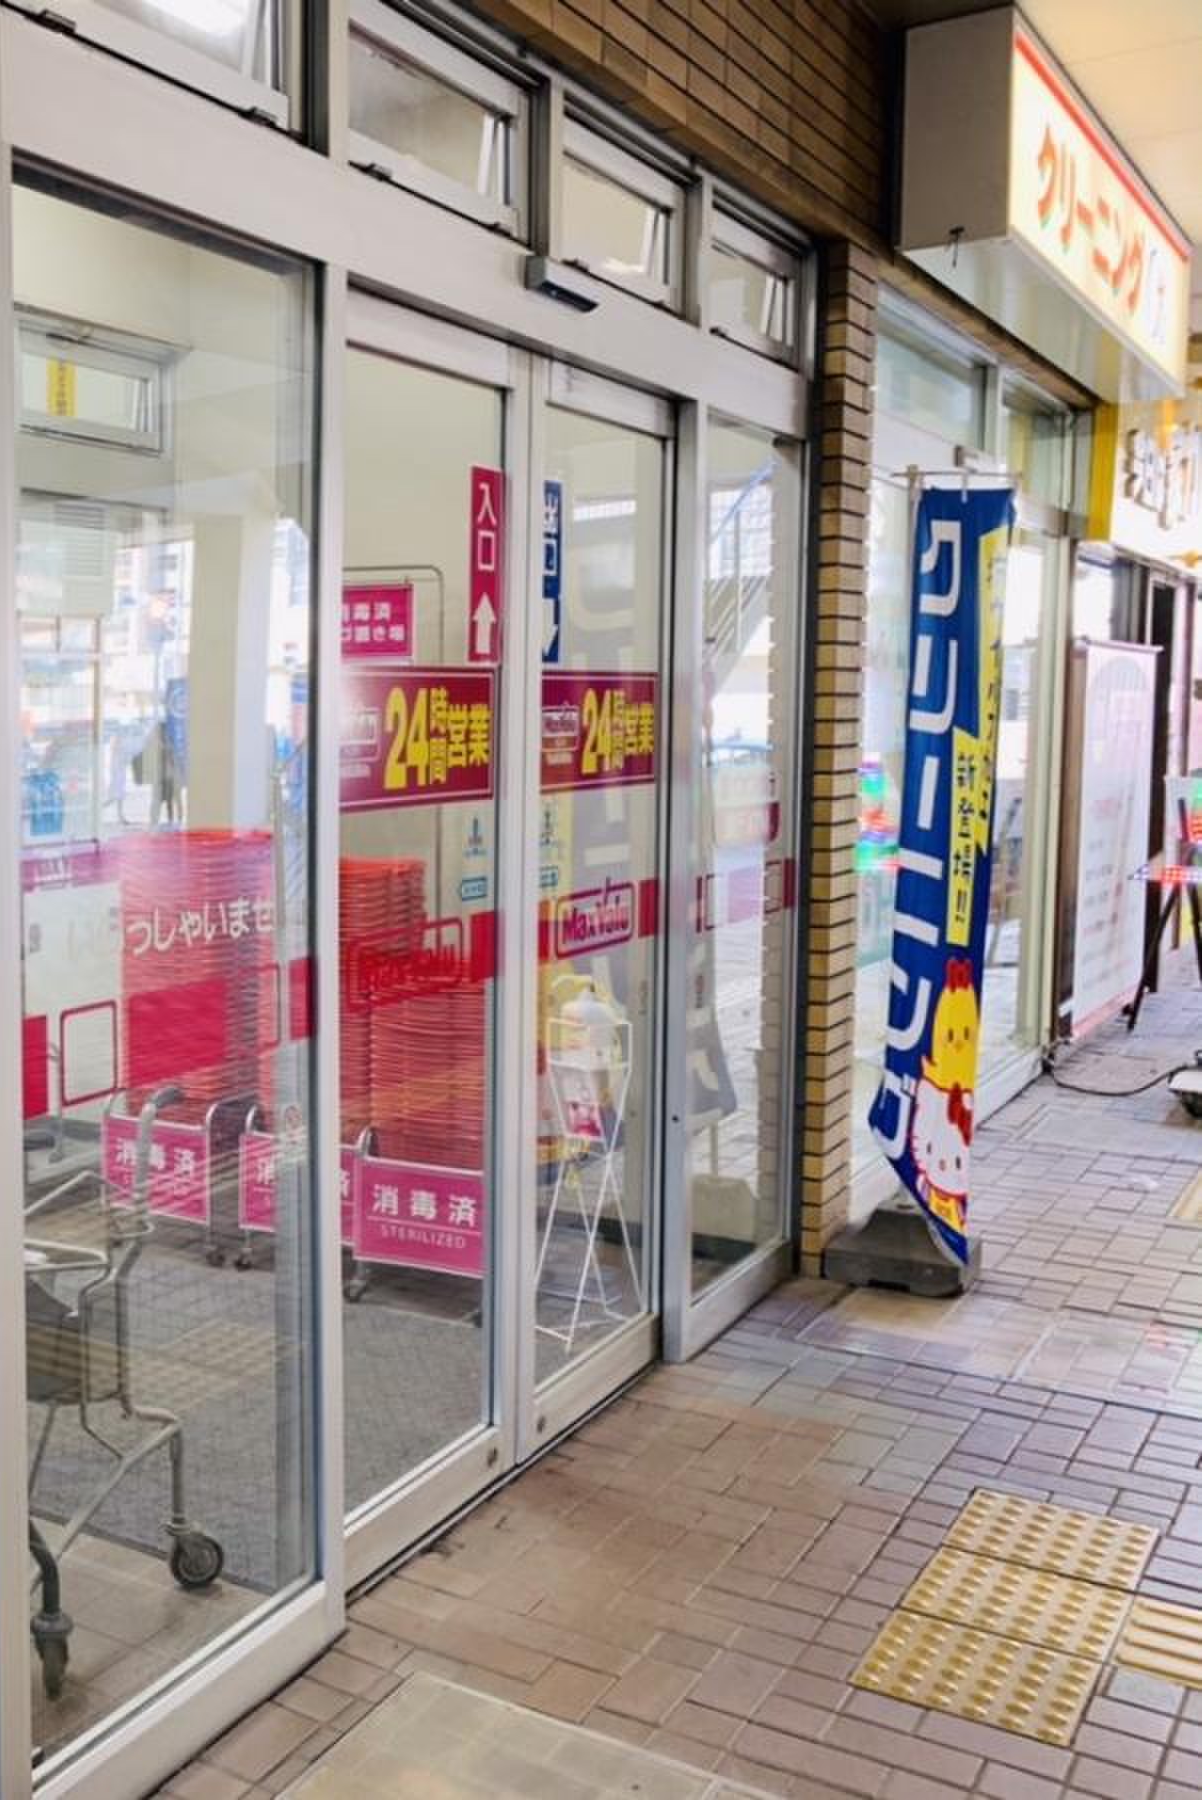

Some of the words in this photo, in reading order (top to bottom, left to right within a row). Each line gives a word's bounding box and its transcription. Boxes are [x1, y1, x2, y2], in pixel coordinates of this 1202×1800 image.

[1037, 125, 1148, 316] クリーニング
[477, 482, 497, 571] 入口
[384, 687, 491, 790] 24時間営業
[581, 687, 655, 775] 24時間営業
[874, 519, 962, 1160] クリーニング
[372, 1183, 477, 1228] 消毒済
